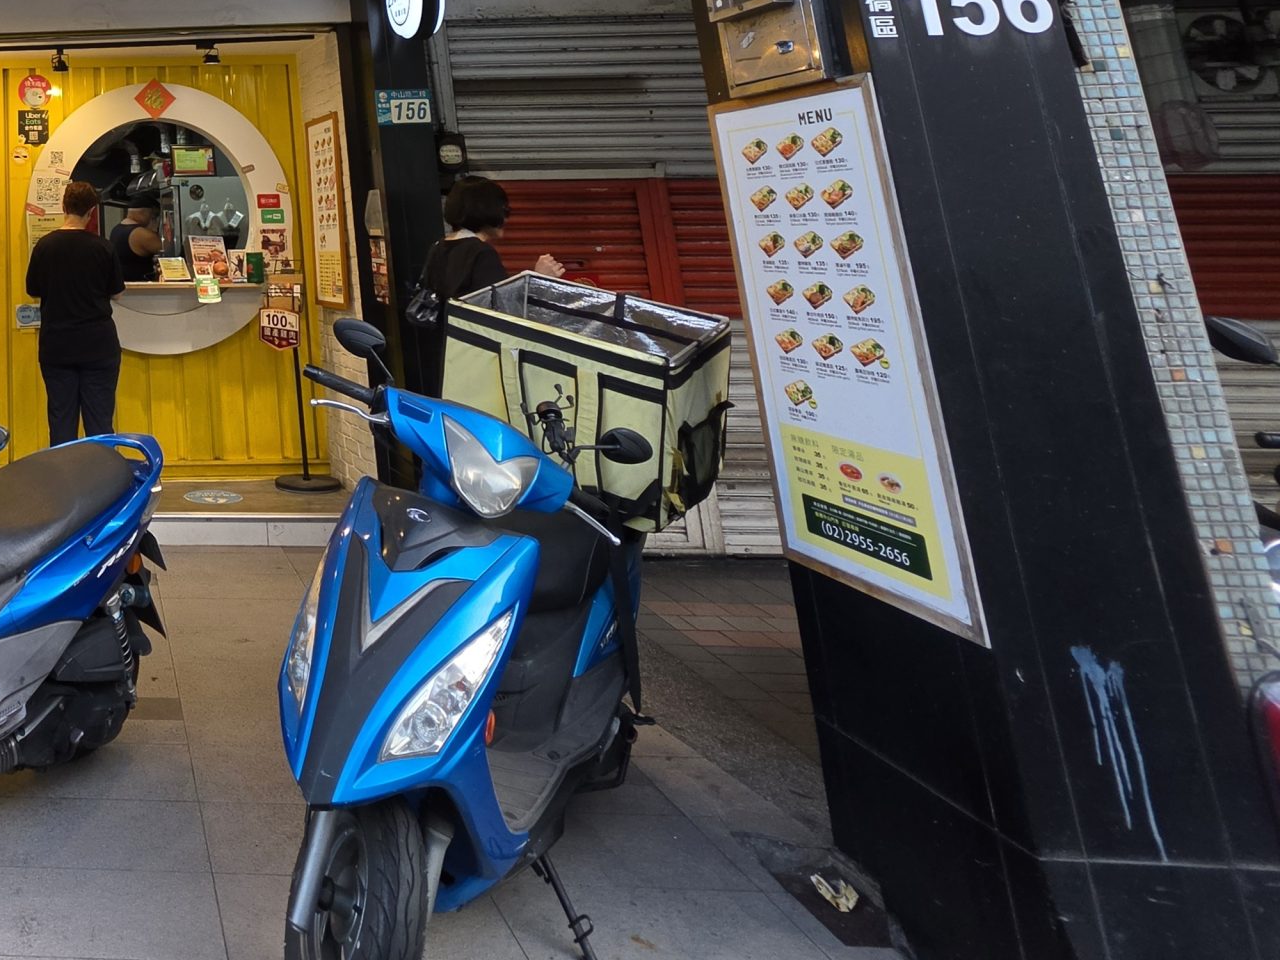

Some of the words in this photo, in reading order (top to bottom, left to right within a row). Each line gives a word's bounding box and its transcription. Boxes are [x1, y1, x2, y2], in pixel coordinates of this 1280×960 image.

[394, 101, 427, 121] 156
[798, 108, 833, 126] MENU
[821, 521, 911, 566] (02)2955-2656
